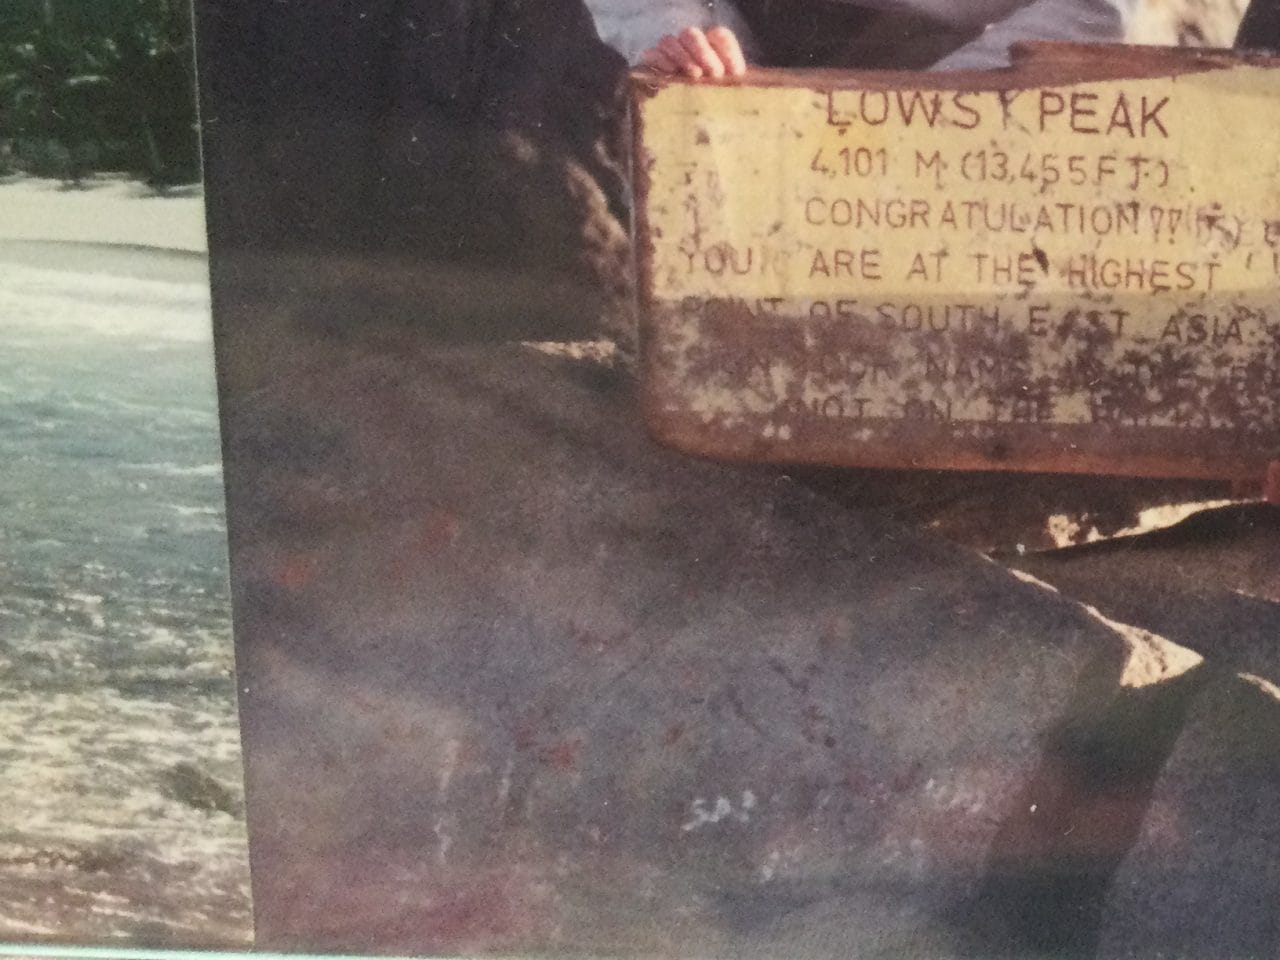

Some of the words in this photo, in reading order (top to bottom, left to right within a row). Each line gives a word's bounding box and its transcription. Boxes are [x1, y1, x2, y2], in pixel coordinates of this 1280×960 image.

[1038, 92, 1170, 139] PEAK
[809, 146, 888, 178] 4,101
[808, 248, 882, 280] ARE
[906, 248, 950, 282] AT
[967, 250, 1037, 286] THE
[1066, 253, 1222, 292] HIGHEST
[876, 301, 1000, 332] SOUTH
